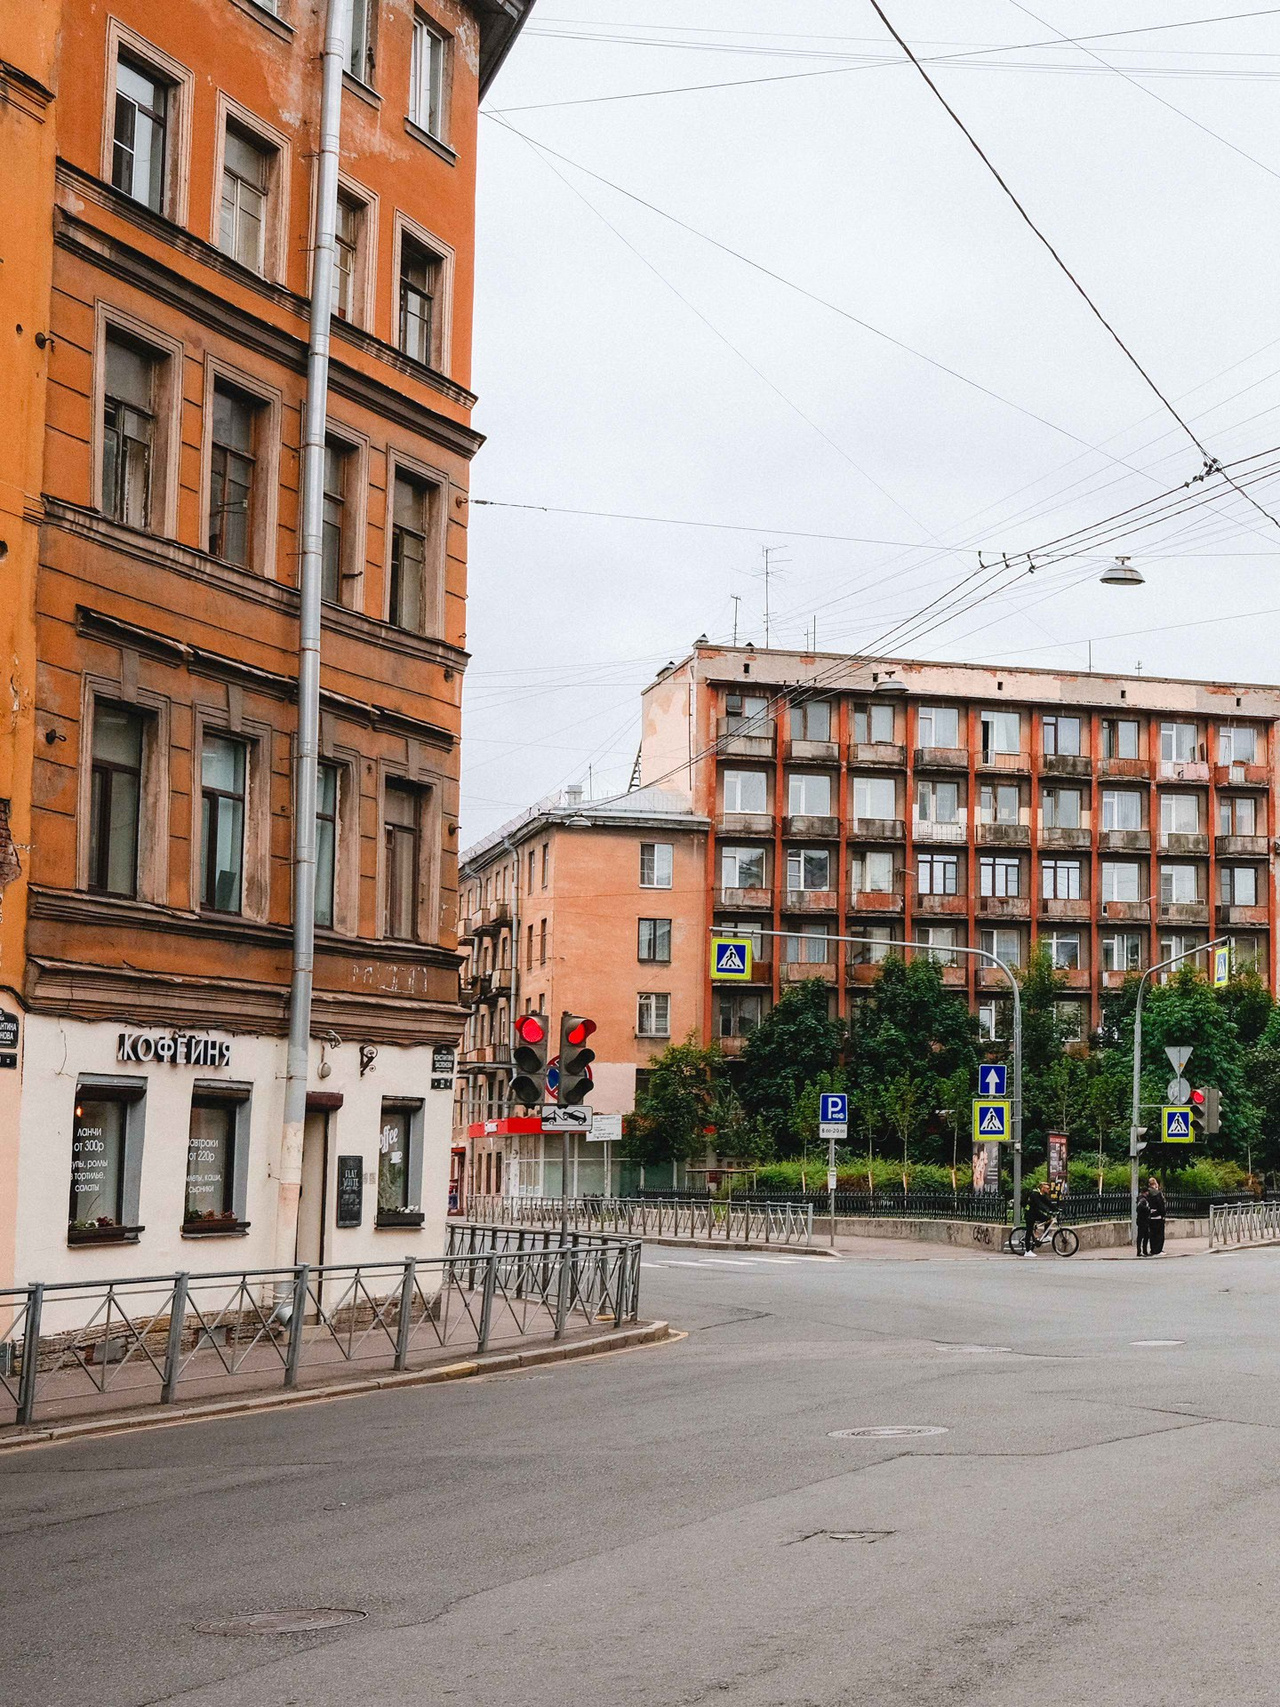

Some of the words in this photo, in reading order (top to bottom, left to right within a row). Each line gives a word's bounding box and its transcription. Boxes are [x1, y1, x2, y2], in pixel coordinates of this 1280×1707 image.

[119, 1033, 231, 1066] КОФЕЙНЯ
[77, 1127, 102, 1137] ланчи
[189, 1139, 219, 1149] автраки
[379, 1124, 398, 1154] offee
[73, 1143, 84, 1152] от
[84, 1140, 105, 1153] 300р
[188, 1152, 197, 1161] от
[197, 1150, 215, 1163] 220р
[71, 1160, 87, 1170] упы,
[74, 1184, 100, 1193] салаты
